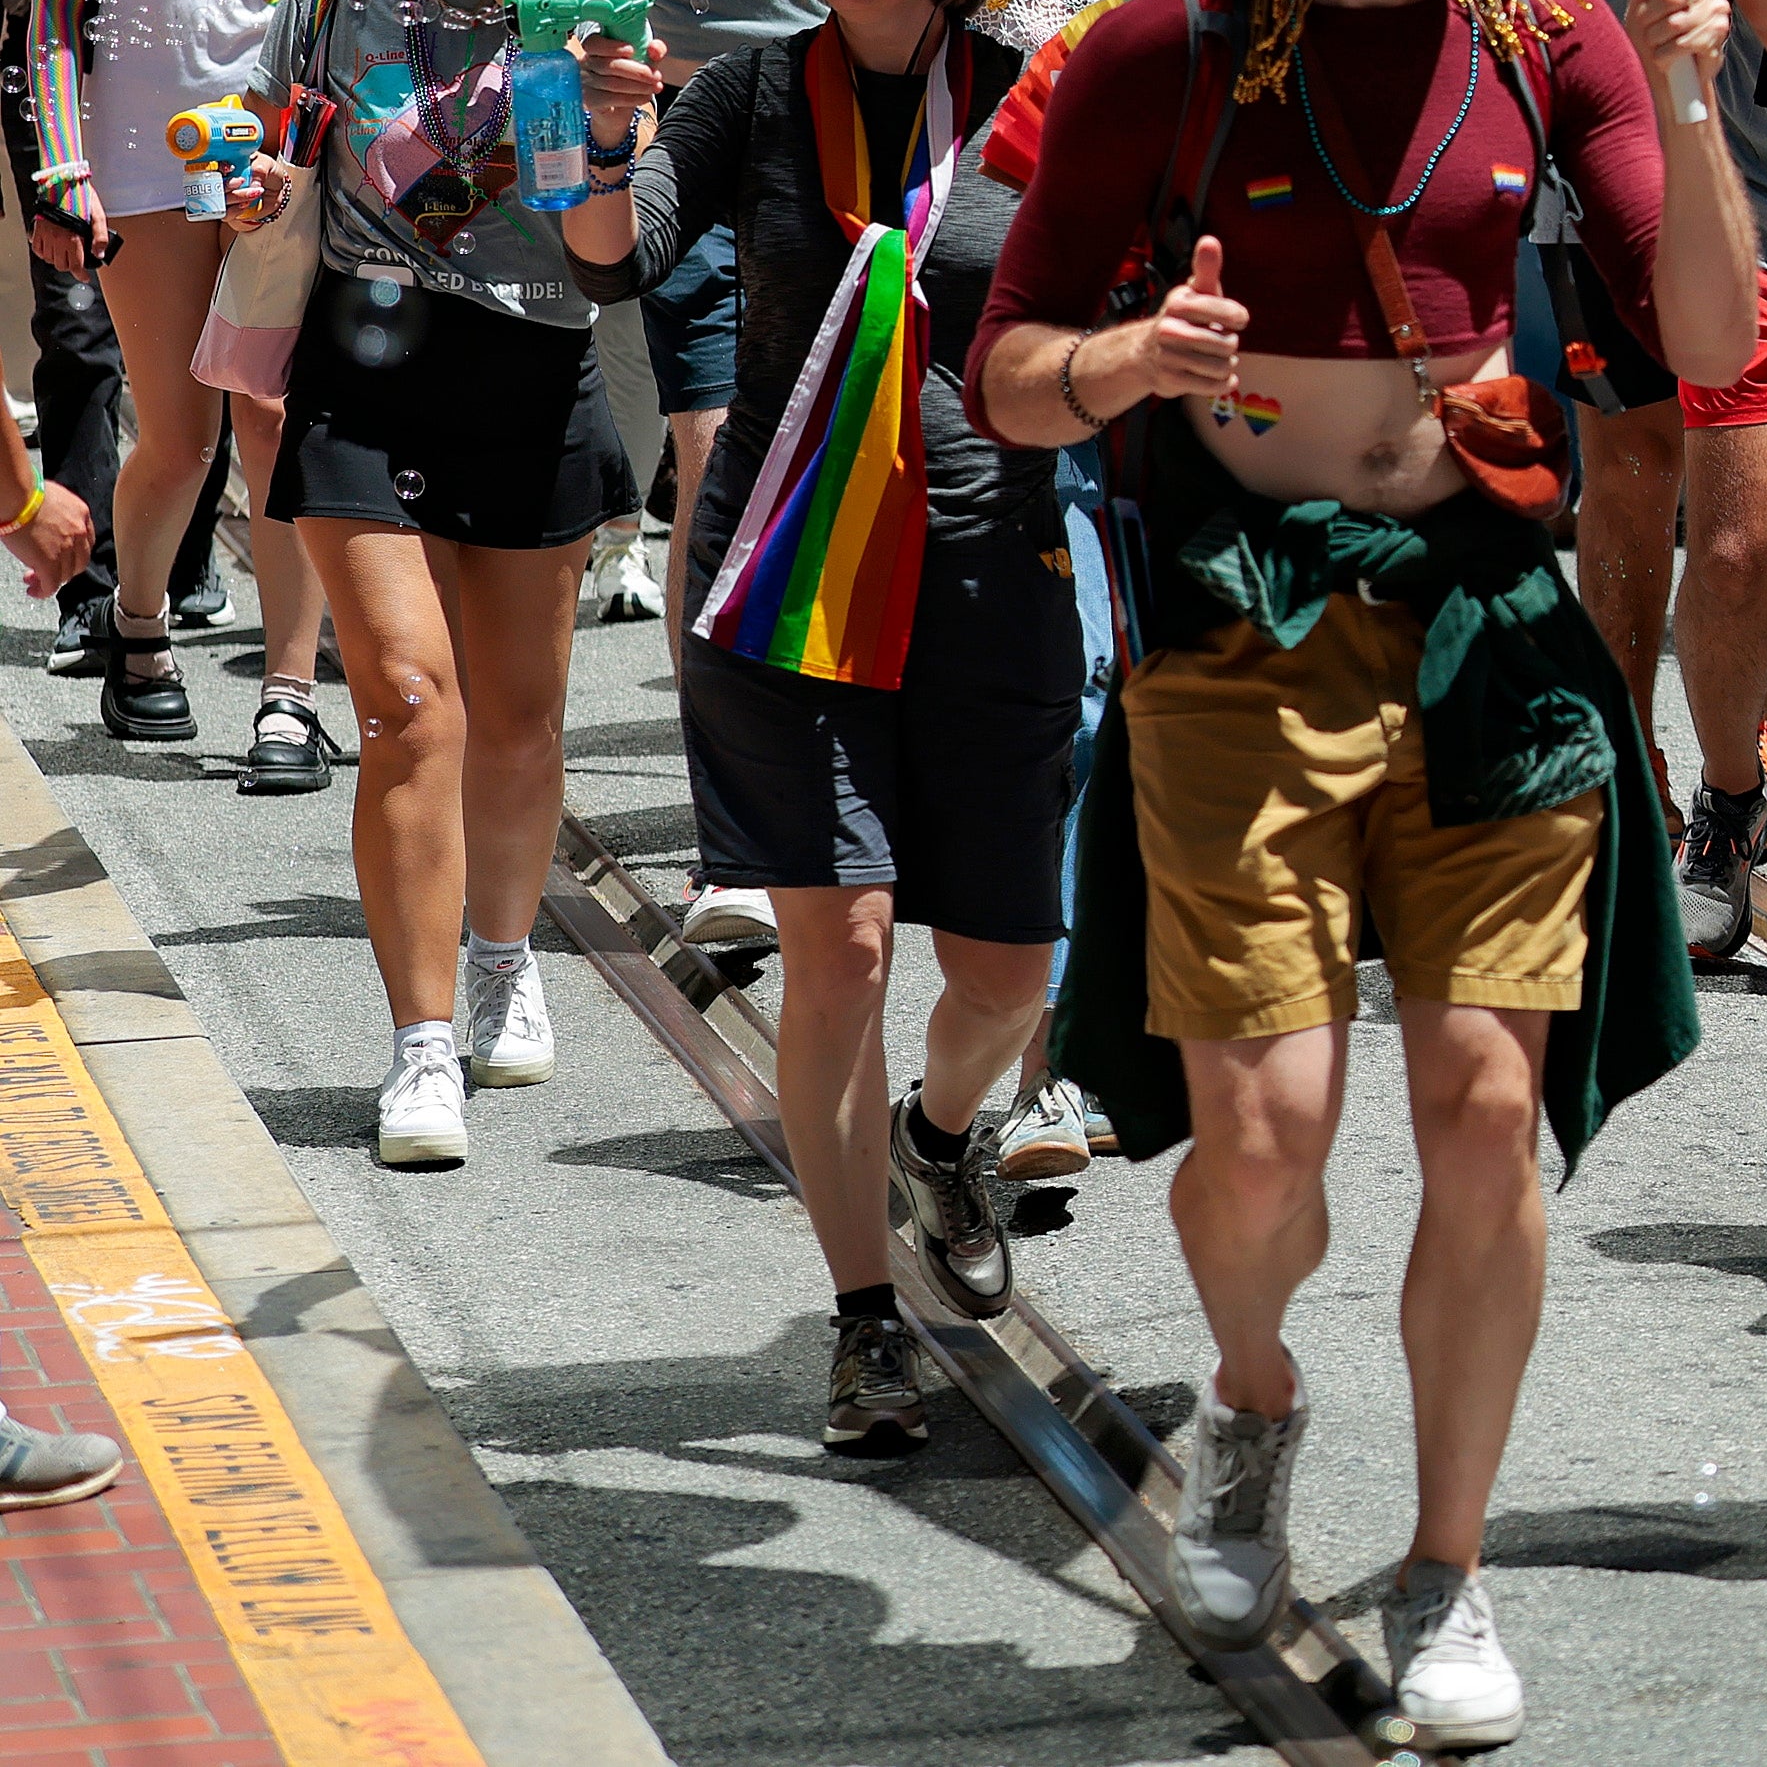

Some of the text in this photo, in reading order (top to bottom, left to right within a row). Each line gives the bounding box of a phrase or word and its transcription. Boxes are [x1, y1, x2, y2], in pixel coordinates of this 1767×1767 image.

[365, 50, 405, 63] Q-Line
[0, 1130, 113, 1174] CROSS
[23, 1178, 144, 1224] STREET
[141, 1394, 267, 1433] STAY
[164, 1442, 304, 1507] BEHIND
[200, 1510, 349, 1587] YELLOW
[240, 1595, 376, 1636] LINE
